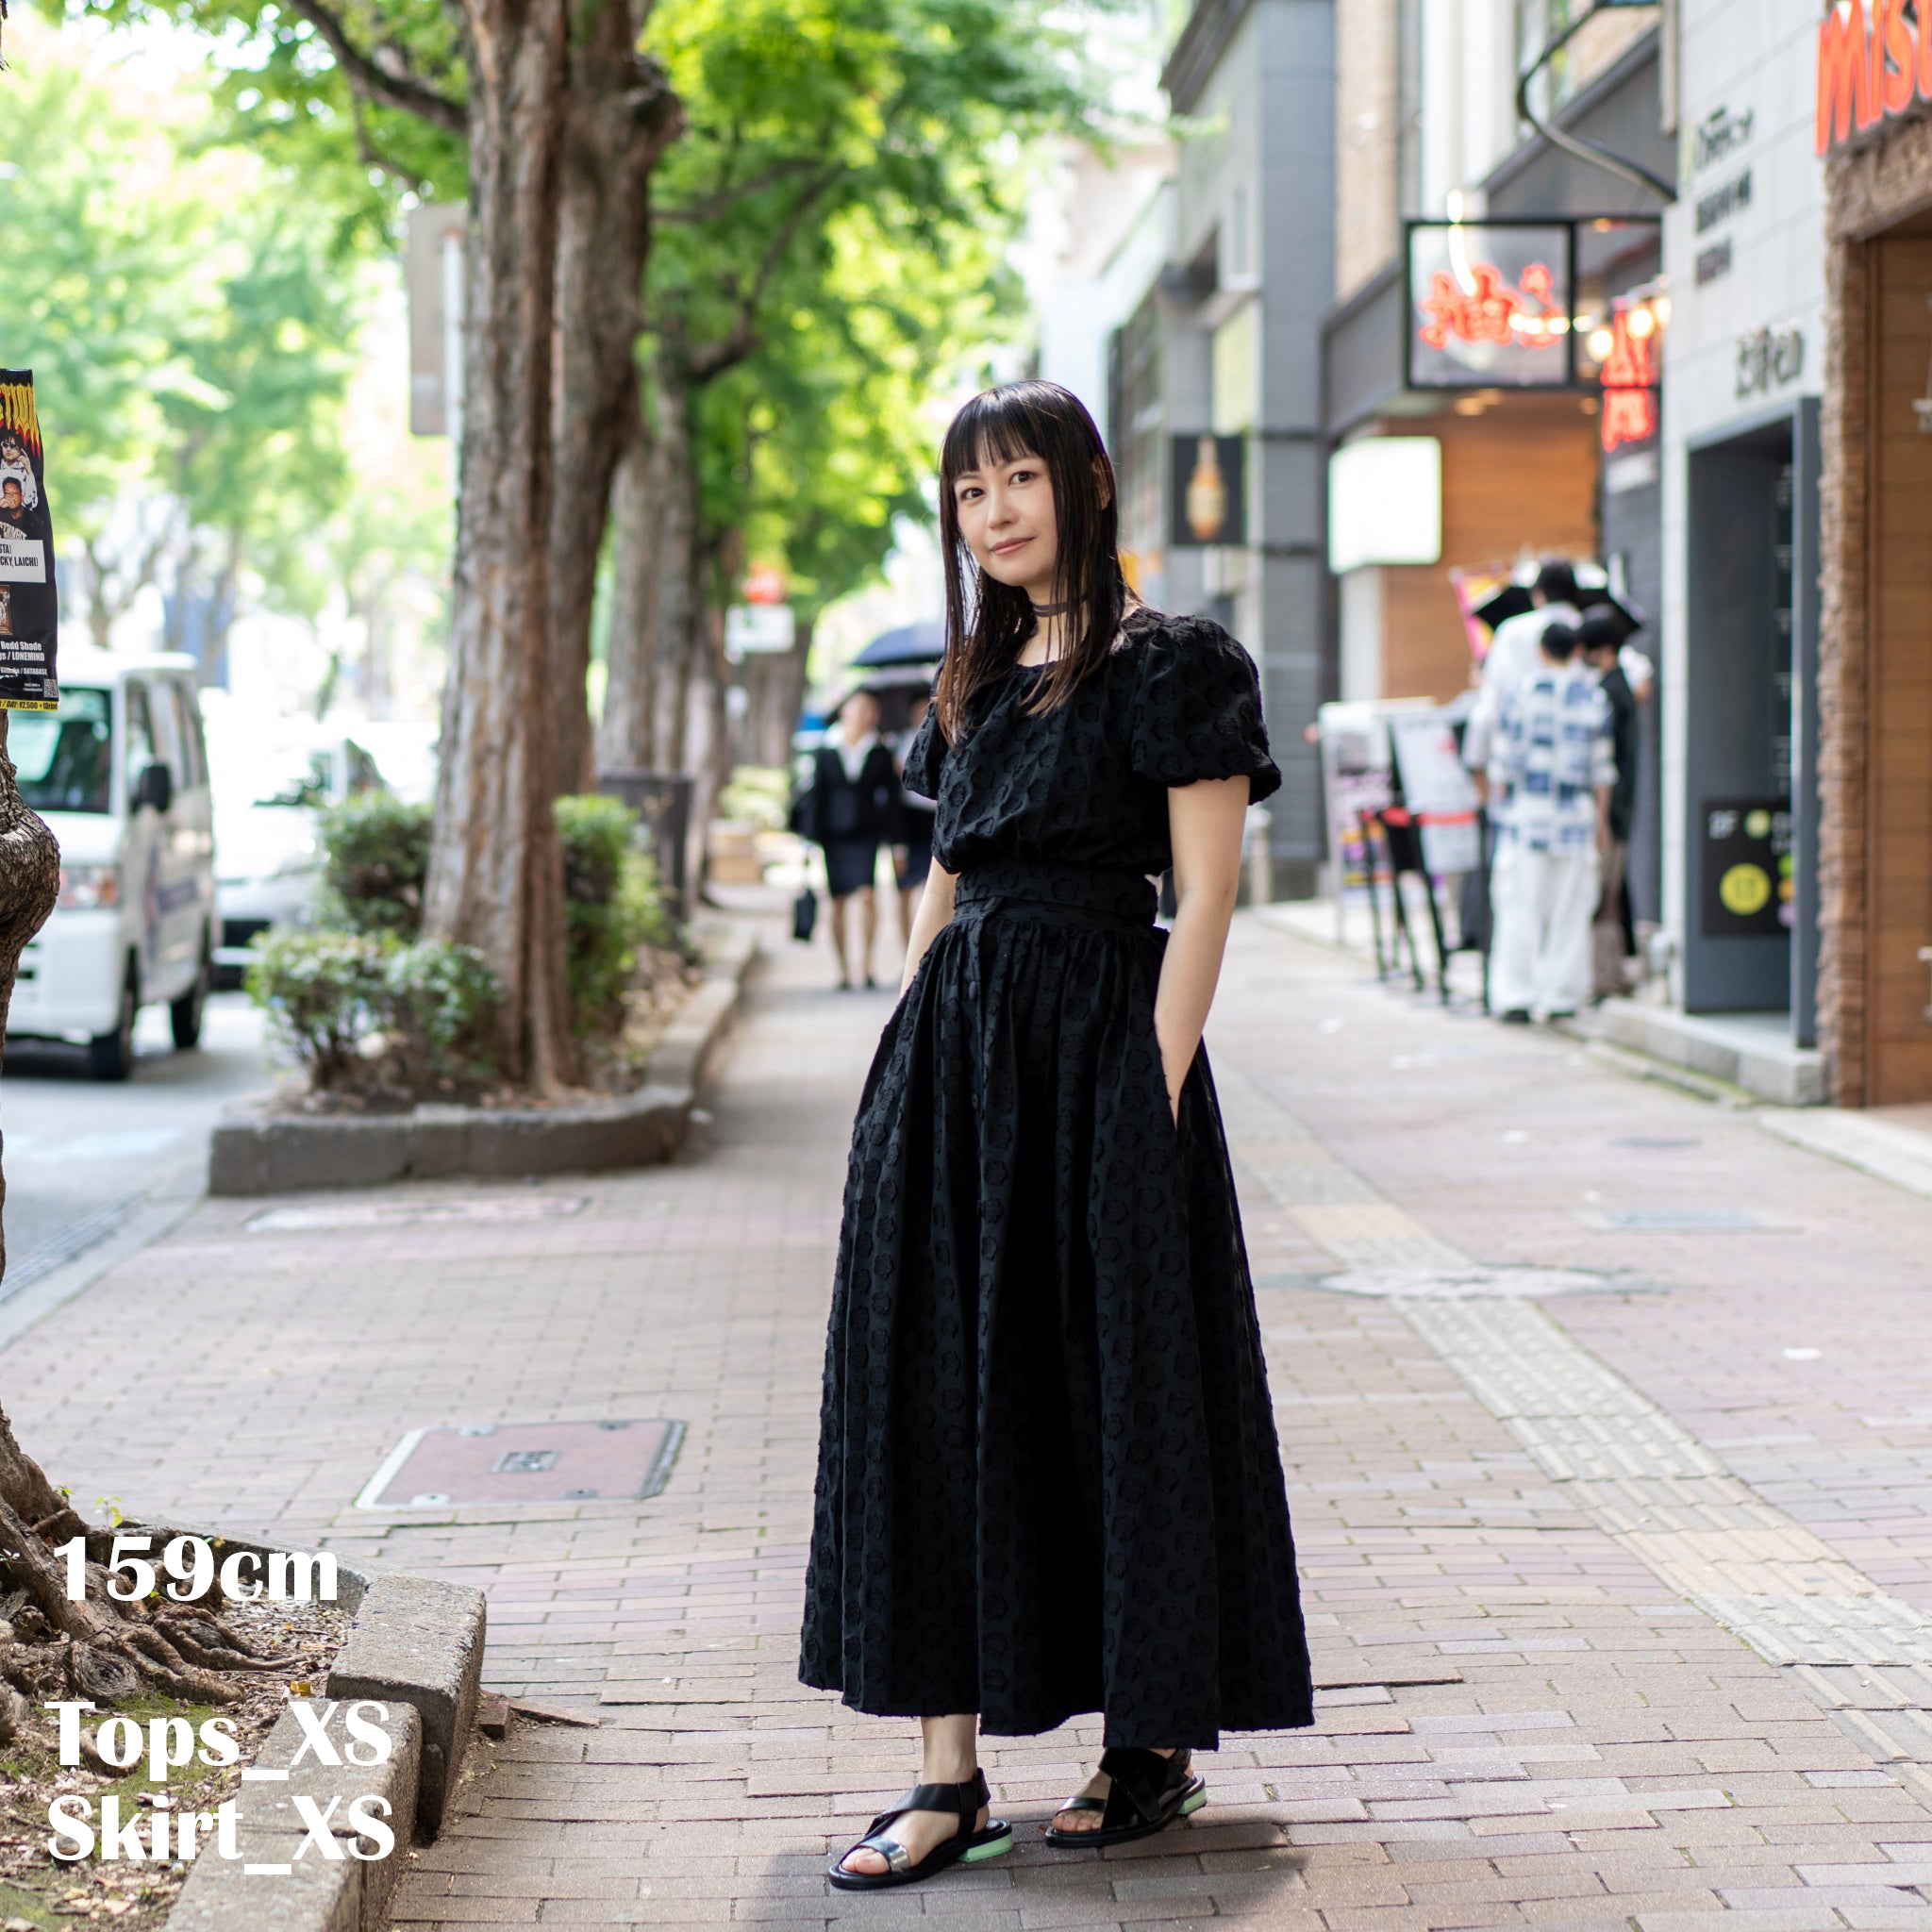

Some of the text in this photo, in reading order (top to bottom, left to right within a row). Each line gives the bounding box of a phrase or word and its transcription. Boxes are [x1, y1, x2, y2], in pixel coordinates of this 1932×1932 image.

[1, 641, 42, 651] Redd Shade
[12, 651, 45, 662] LONEMIND
